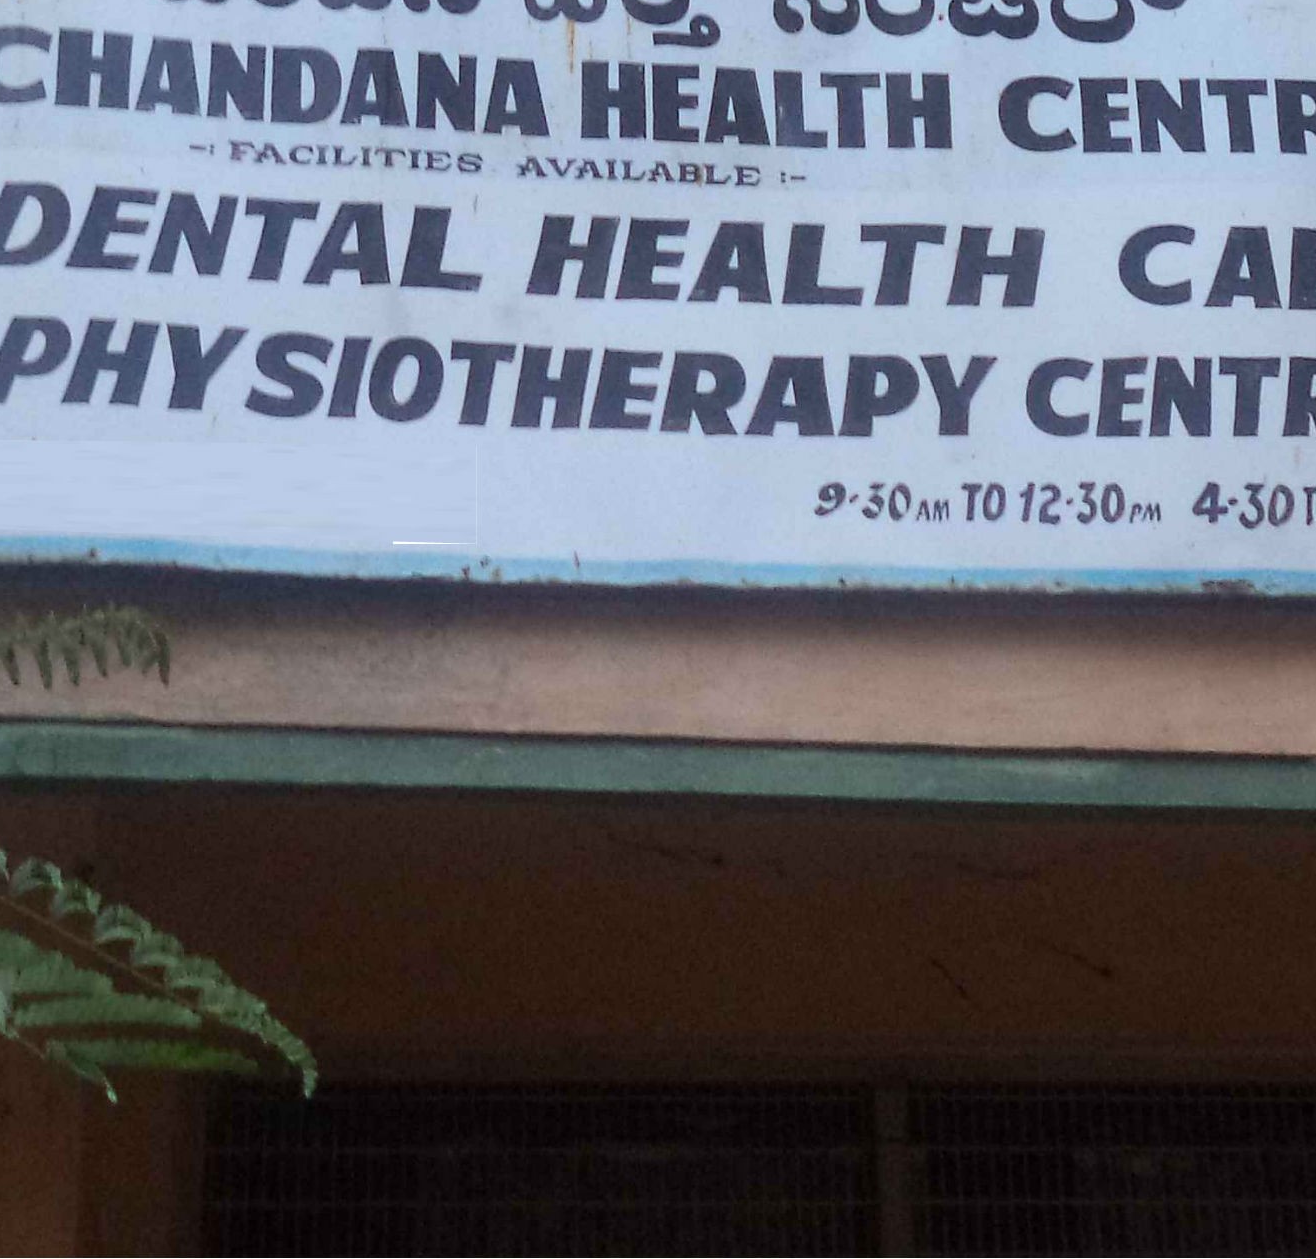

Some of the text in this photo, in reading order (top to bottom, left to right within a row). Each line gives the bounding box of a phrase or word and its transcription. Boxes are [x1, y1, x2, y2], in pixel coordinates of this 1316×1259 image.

[581, 61, 952, 149] HEALTH
[231, 142, 483, 172] FACILITIES
[519, 157, 760, 186] AVAILABLE
[526, 215, 1045, 307] HEALTH
